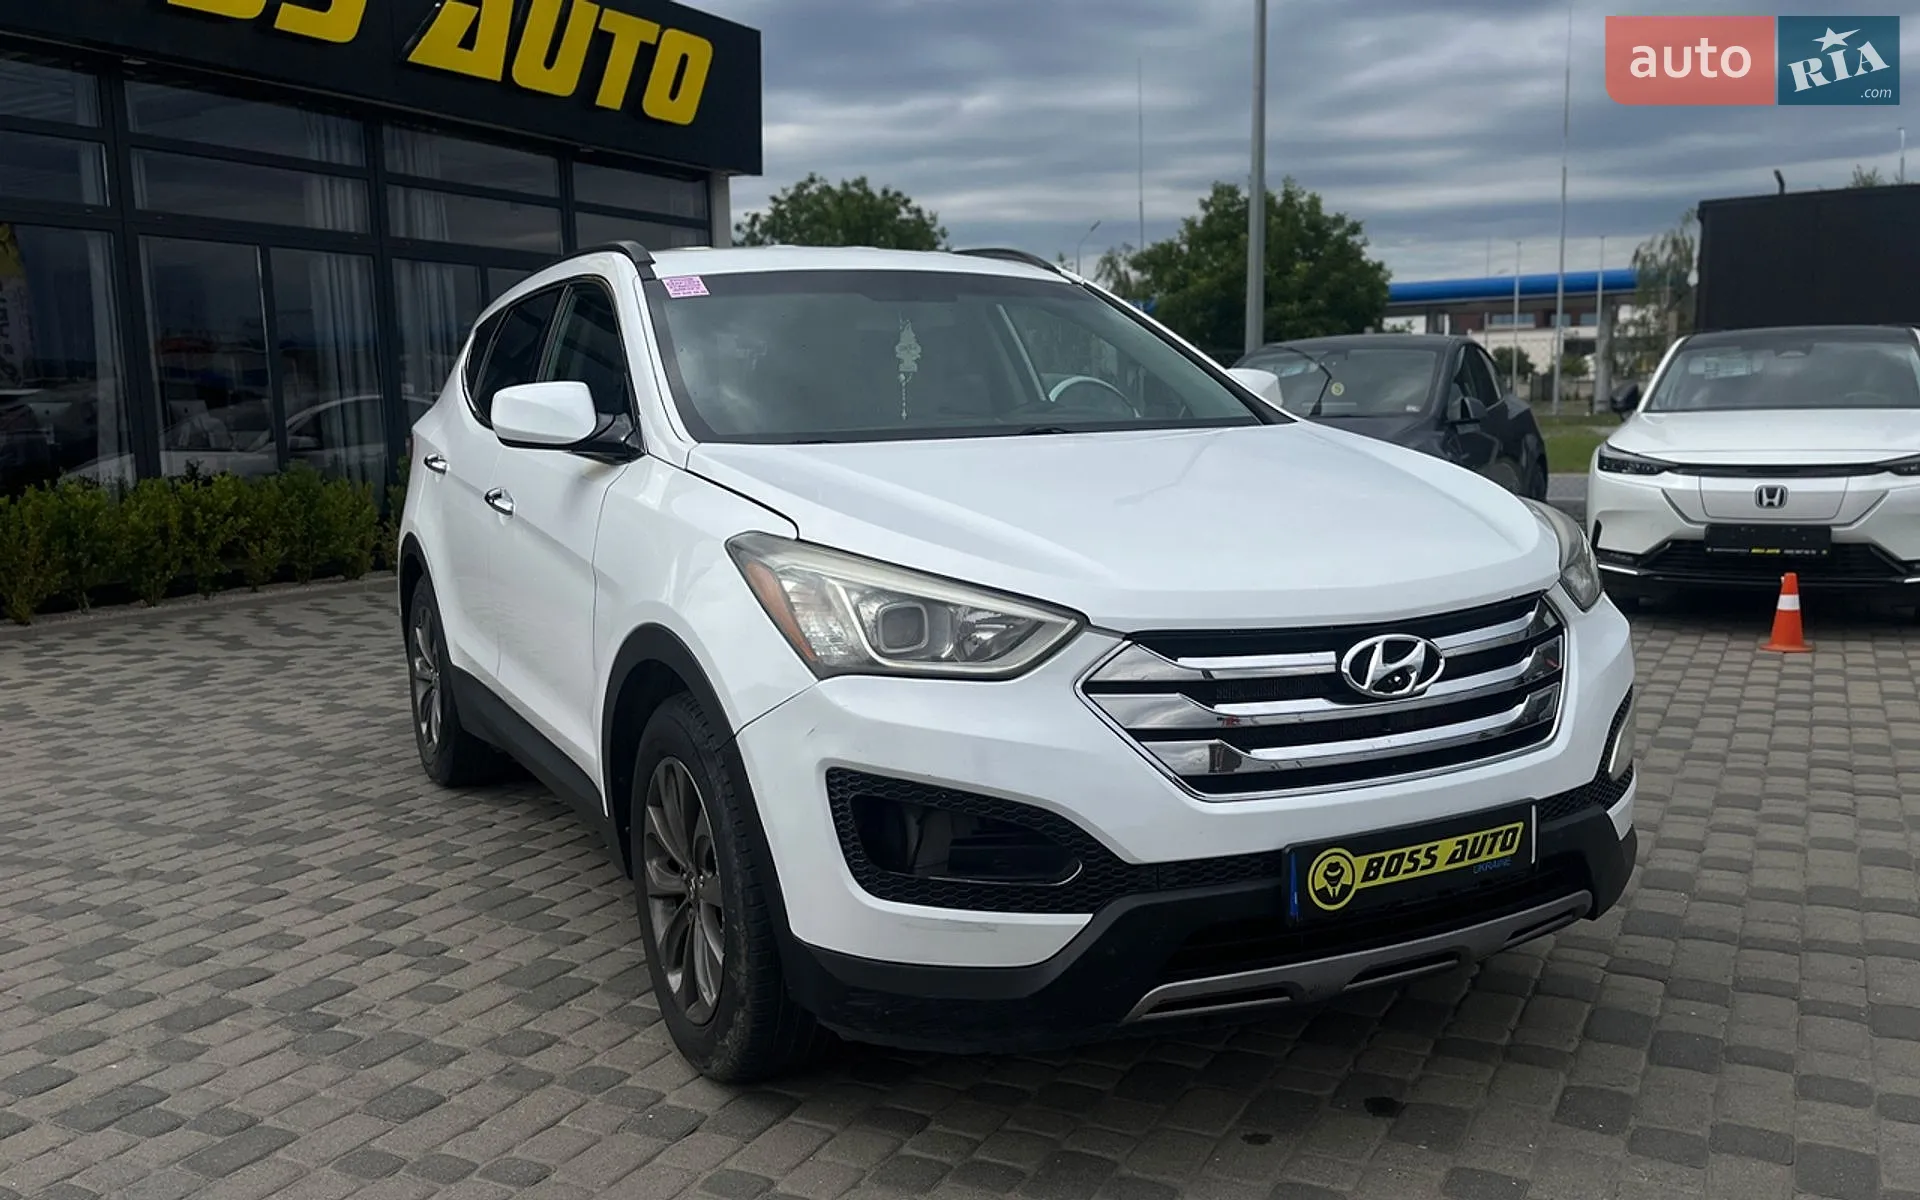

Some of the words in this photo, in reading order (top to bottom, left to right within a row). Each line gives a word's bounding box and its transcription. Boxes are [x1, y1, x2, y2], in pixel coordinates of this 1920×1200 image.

[407, 0, 713, 125] AUTO
[1361, 845, 1439, 883] BOSS
[1446, 826, 1519, 866] AUTO
[1473, 857, 1512, 874] UKRAINE
